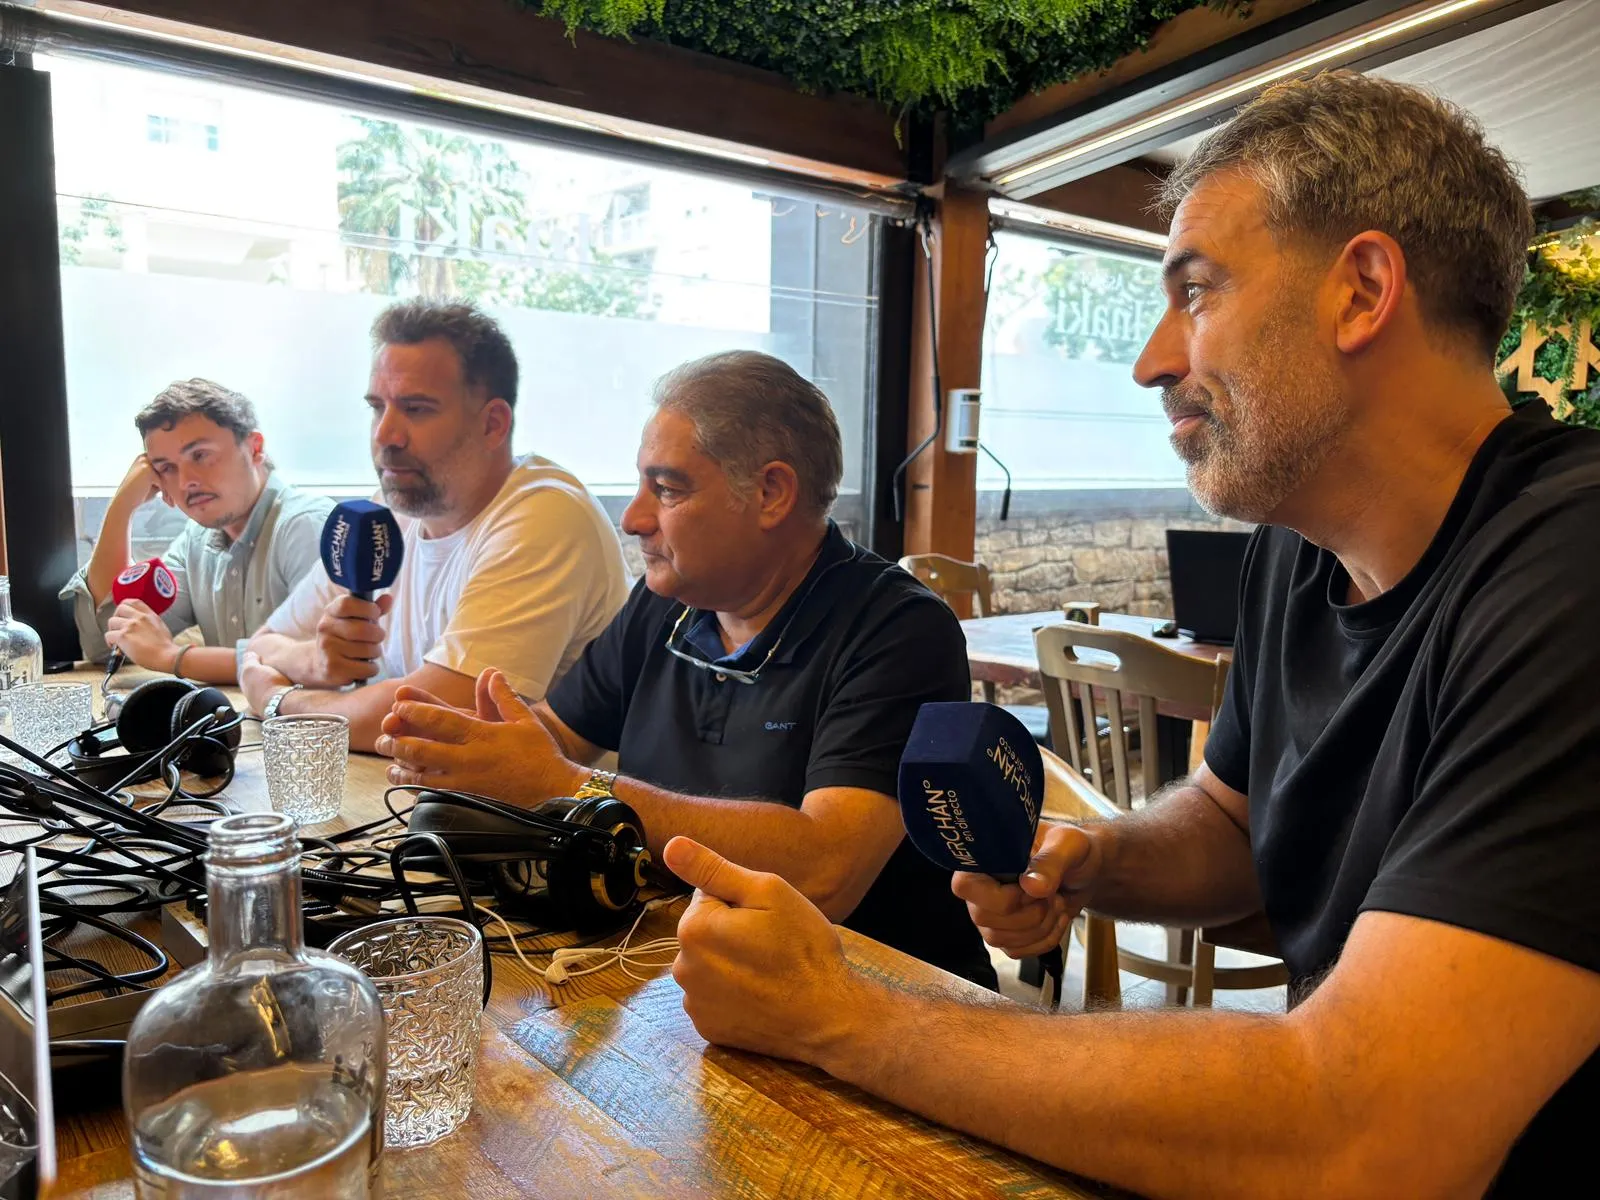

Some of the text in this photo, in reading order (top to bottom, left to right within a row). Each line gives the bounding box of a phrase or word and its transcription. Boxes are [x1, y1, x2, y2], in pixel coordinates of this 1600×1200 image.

[764, 721, 797, 730] GANT
[947, 789, 975, 842] en directo
